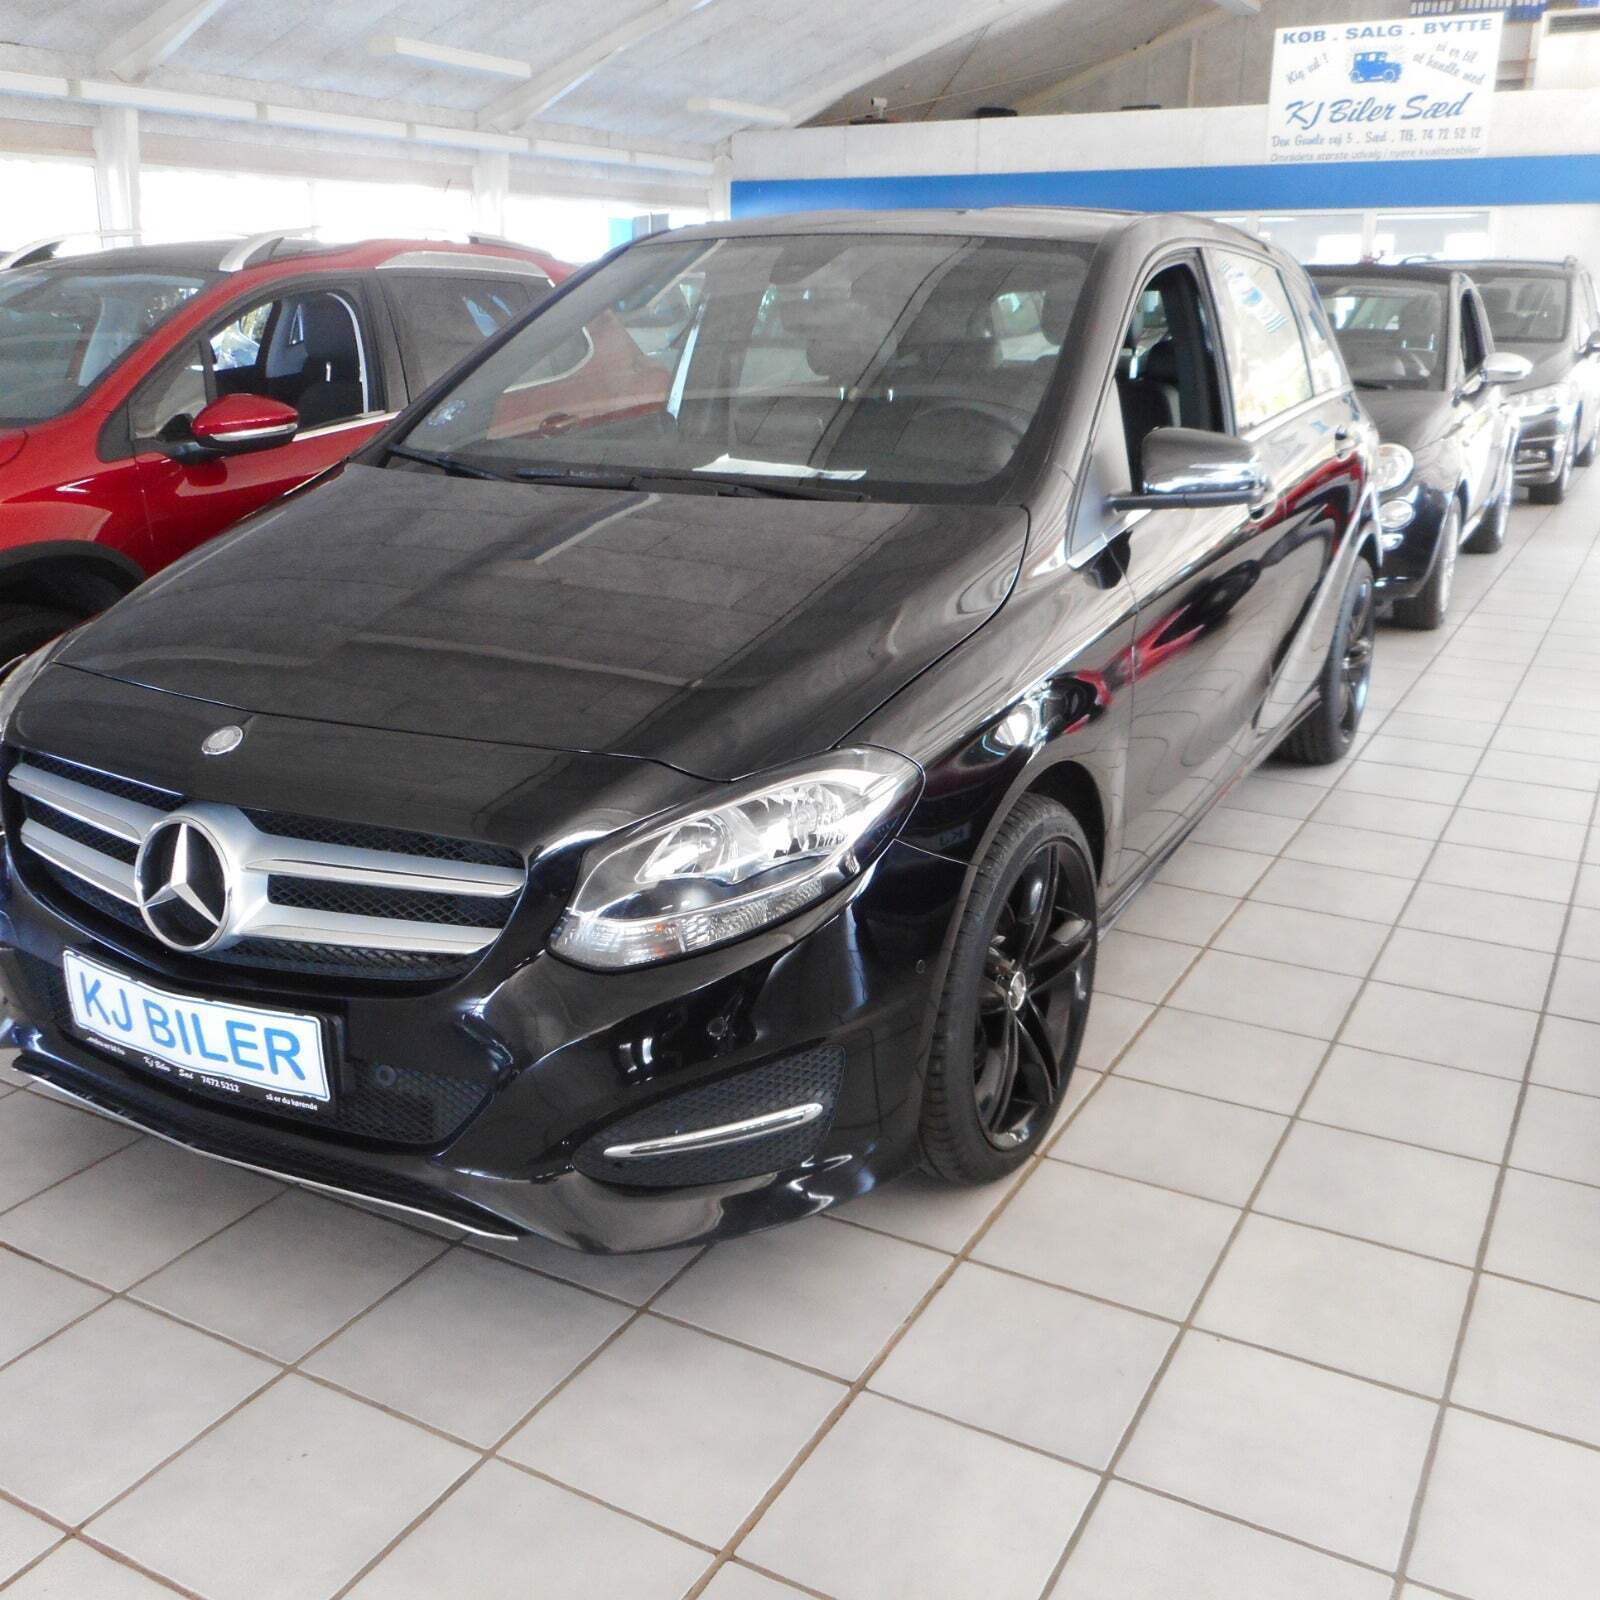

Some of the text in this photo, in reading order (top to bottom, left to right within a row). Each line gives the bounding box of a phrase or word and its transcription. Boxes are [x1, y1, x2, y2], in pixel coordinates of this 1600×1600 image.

[1345, 25, 1403, 39] SALG
[1423, 18, 1492, 34] BYTTE
[1285, 92, 1473, 130] KJ Biler Sæd
[1422, 129, 1433, 140] 74
[1439, 128, 1450, 139] 72
[1454, 127, 1466, 139] 52
[1471, 126, 1482, 138] 12
[80, 970, 305, 1080] KJ BILER
